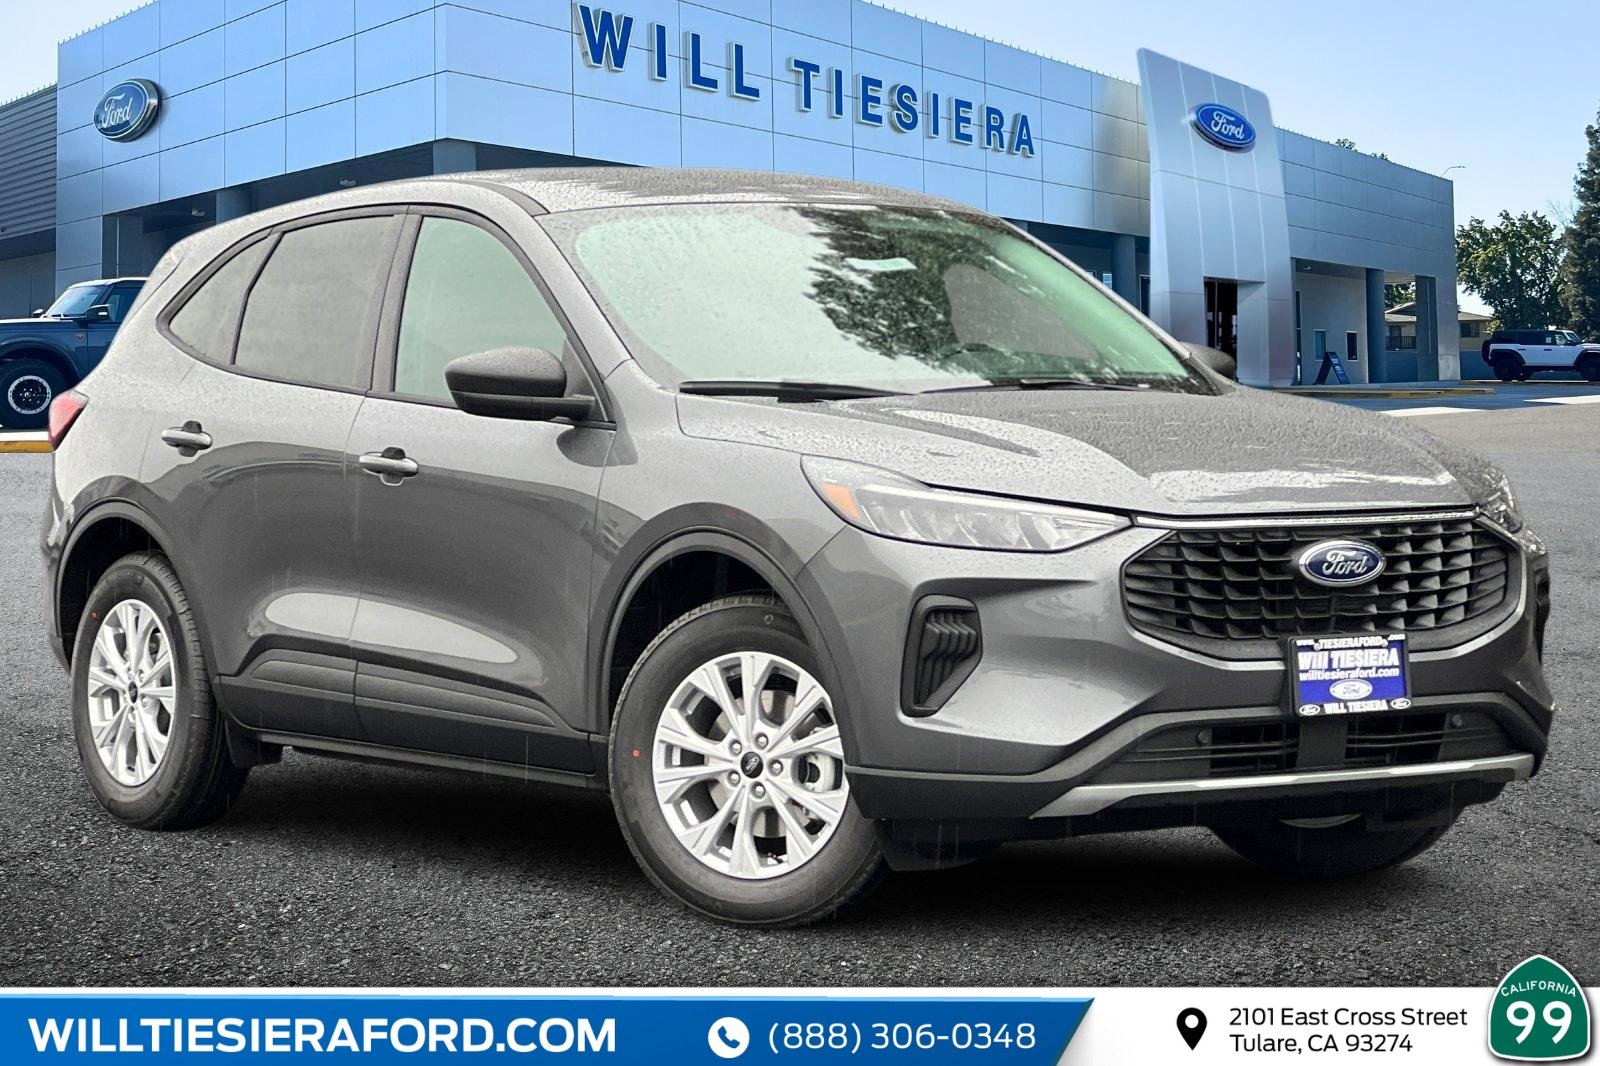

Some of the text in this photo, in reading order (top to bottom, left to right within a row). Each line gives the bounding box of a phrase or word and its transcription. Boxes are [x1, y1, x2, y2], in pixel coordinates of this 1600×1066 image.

[576, 2, 1036, 158] WILL TIESIERA
[101, 93, 133, 128] Ford
[1211, 110, 1245, 140] Ford
[1322, 550, 1368, 576] Ford
[1330, 647, 1400, 669] TIESIERA
[1299, 666, 1400, 681] willtiesieraford.com
[1323, 702, 1347, 715] WILL
[1346, 699, 1388, 713] TIESIERA
